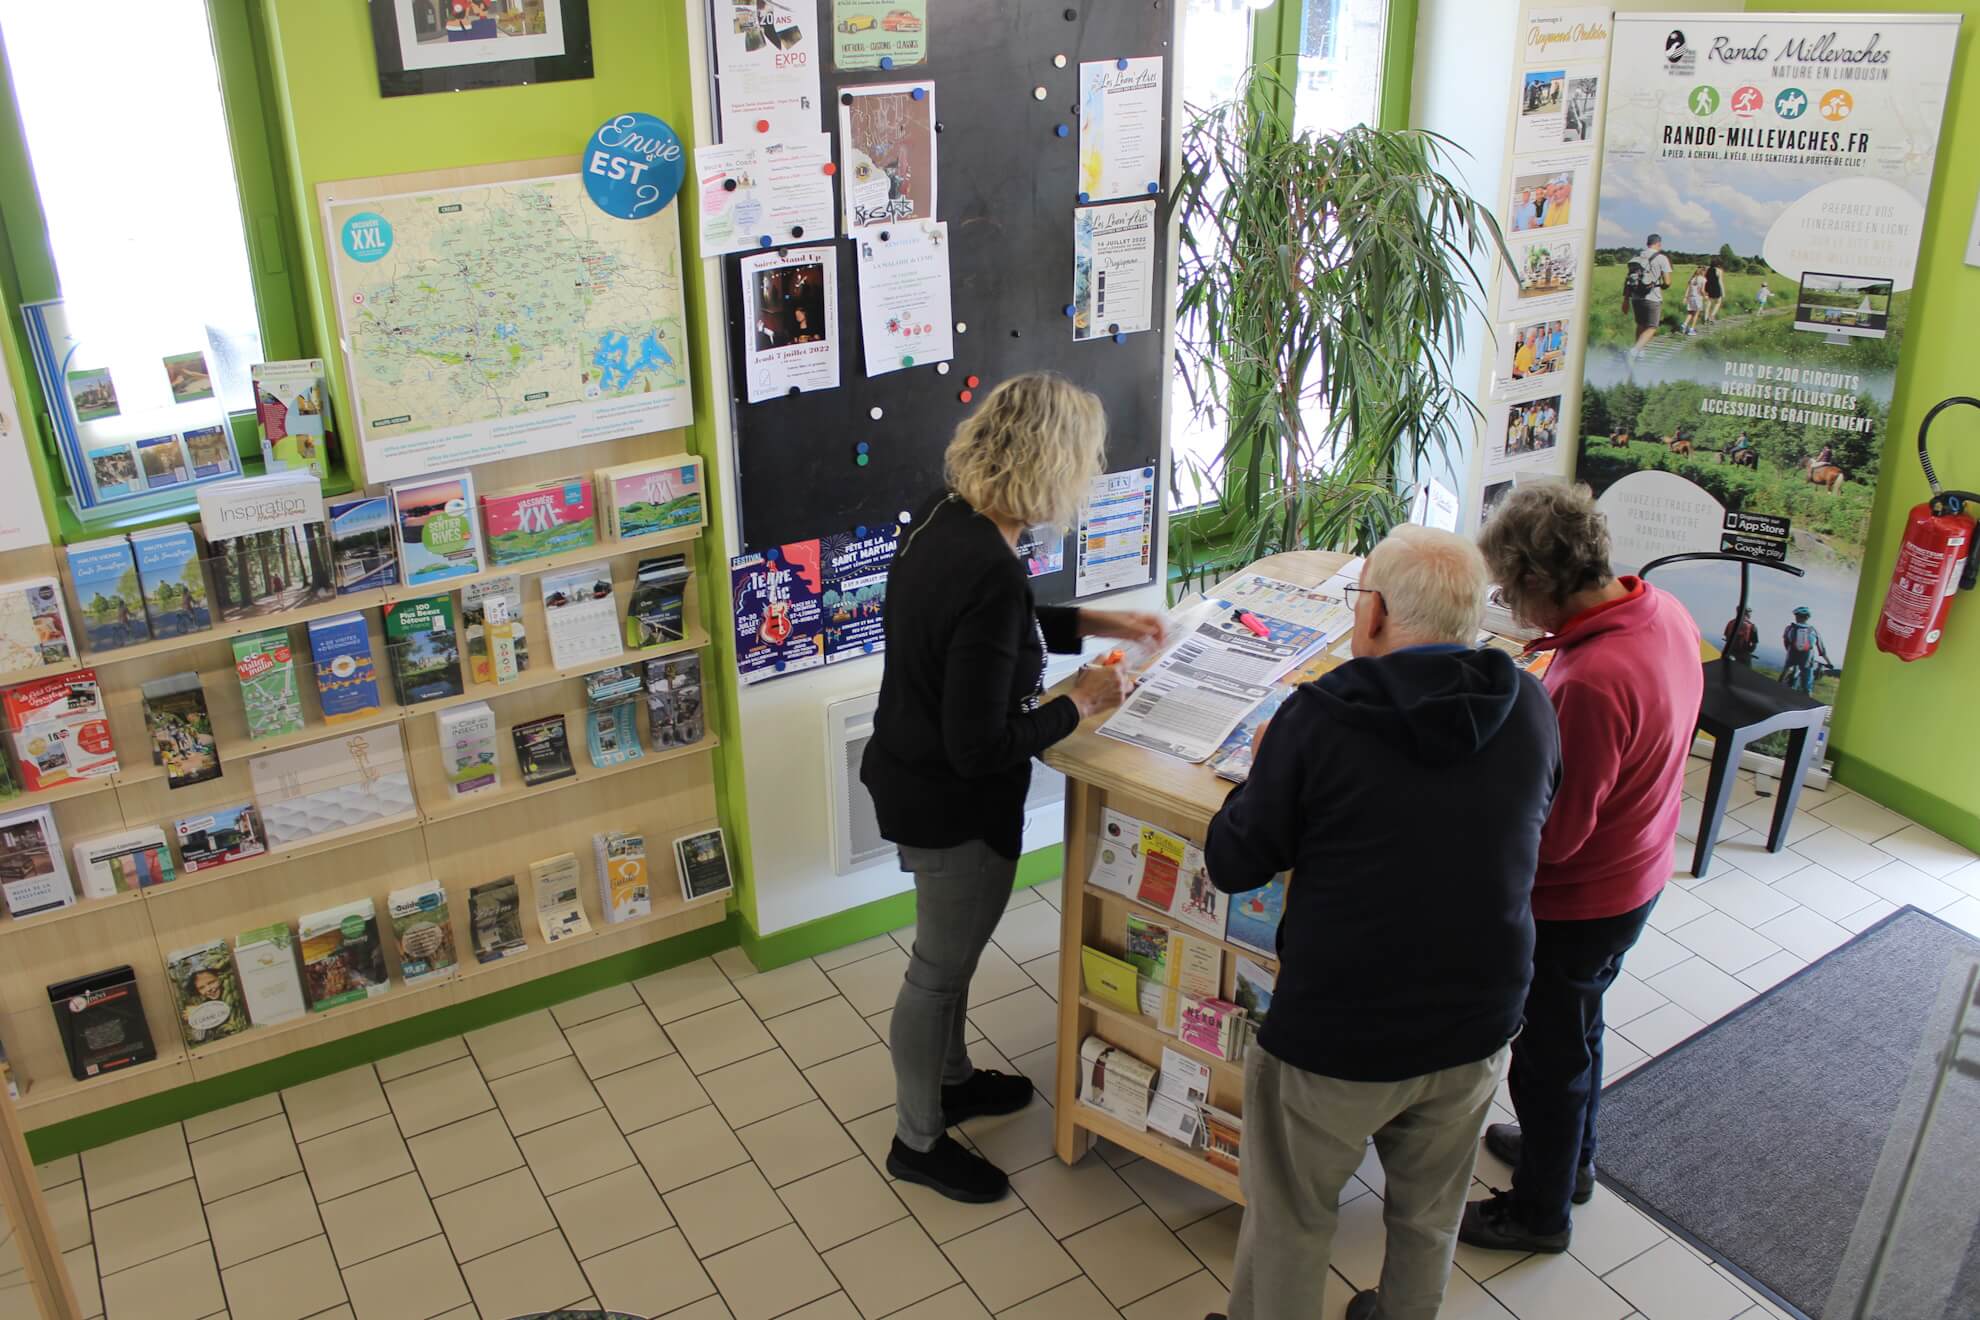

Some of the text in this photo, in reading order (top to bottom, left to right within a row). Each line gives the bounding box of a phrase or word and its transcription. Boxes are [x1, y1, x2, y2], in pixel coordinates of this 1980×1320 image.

[758, 11, 793, 25] 20 ANS
[1708, 31, 1891, 65] Rando Millevaches
[775, 52, 807, 66] EXPO
[1771, 65, 1889, 82] NATURE EN LIMOUSIN
[598, 115, 681, 162] Envie
[1663, 125, 1869, 153] RANDO-MILLEVACHES.FR
[589, 150, 649, 185] EST
[1751, 153, 1764, 162] LES
[1765, 154, 1798, 164] SENTIERS
[1834, 157, 1844, 165] DE
[1845, 157, 1861, 167] CLIC
[351, 227, 386, 250] XXL
[780, 255, 806, 263] Stand
[754, 354, 775, 364] Jeudi
[783, 350, 807, 359] juillet
[809, 345, 830, 353] 2022
[1724, 361, 1860, 390] PLUS DE 200 CIRCUITS
[1721, 380, 1857, 411] DÉCRITS ET ILLUSTRÉS
[1701, 398, 1873, 433] ACCESSIBLES GRATUITEMENT
[220, 496, 306, 523] Inspiration
[518, 503, 565, 533] XXL
[429, 518, 461, 532] SENTIER
[1739, 520, 1785, 535] App Store
[431, 528, 461, 546] RIVES
[845, 536, 885, 553] FÊTE DE LA
[732, 552, 763, 566] FESTIVAL
[831, 551, 858, 567] SAINT
[1734, 543, 1784, 560] Google play
[756, 589, 767, 598] DE
[415, 603, 430, 611] 100
[238, 656, 265, 673] Visiter
[249, 661, 274, 676] malin
[1186, 1005, 1223, 1030] NEXON
